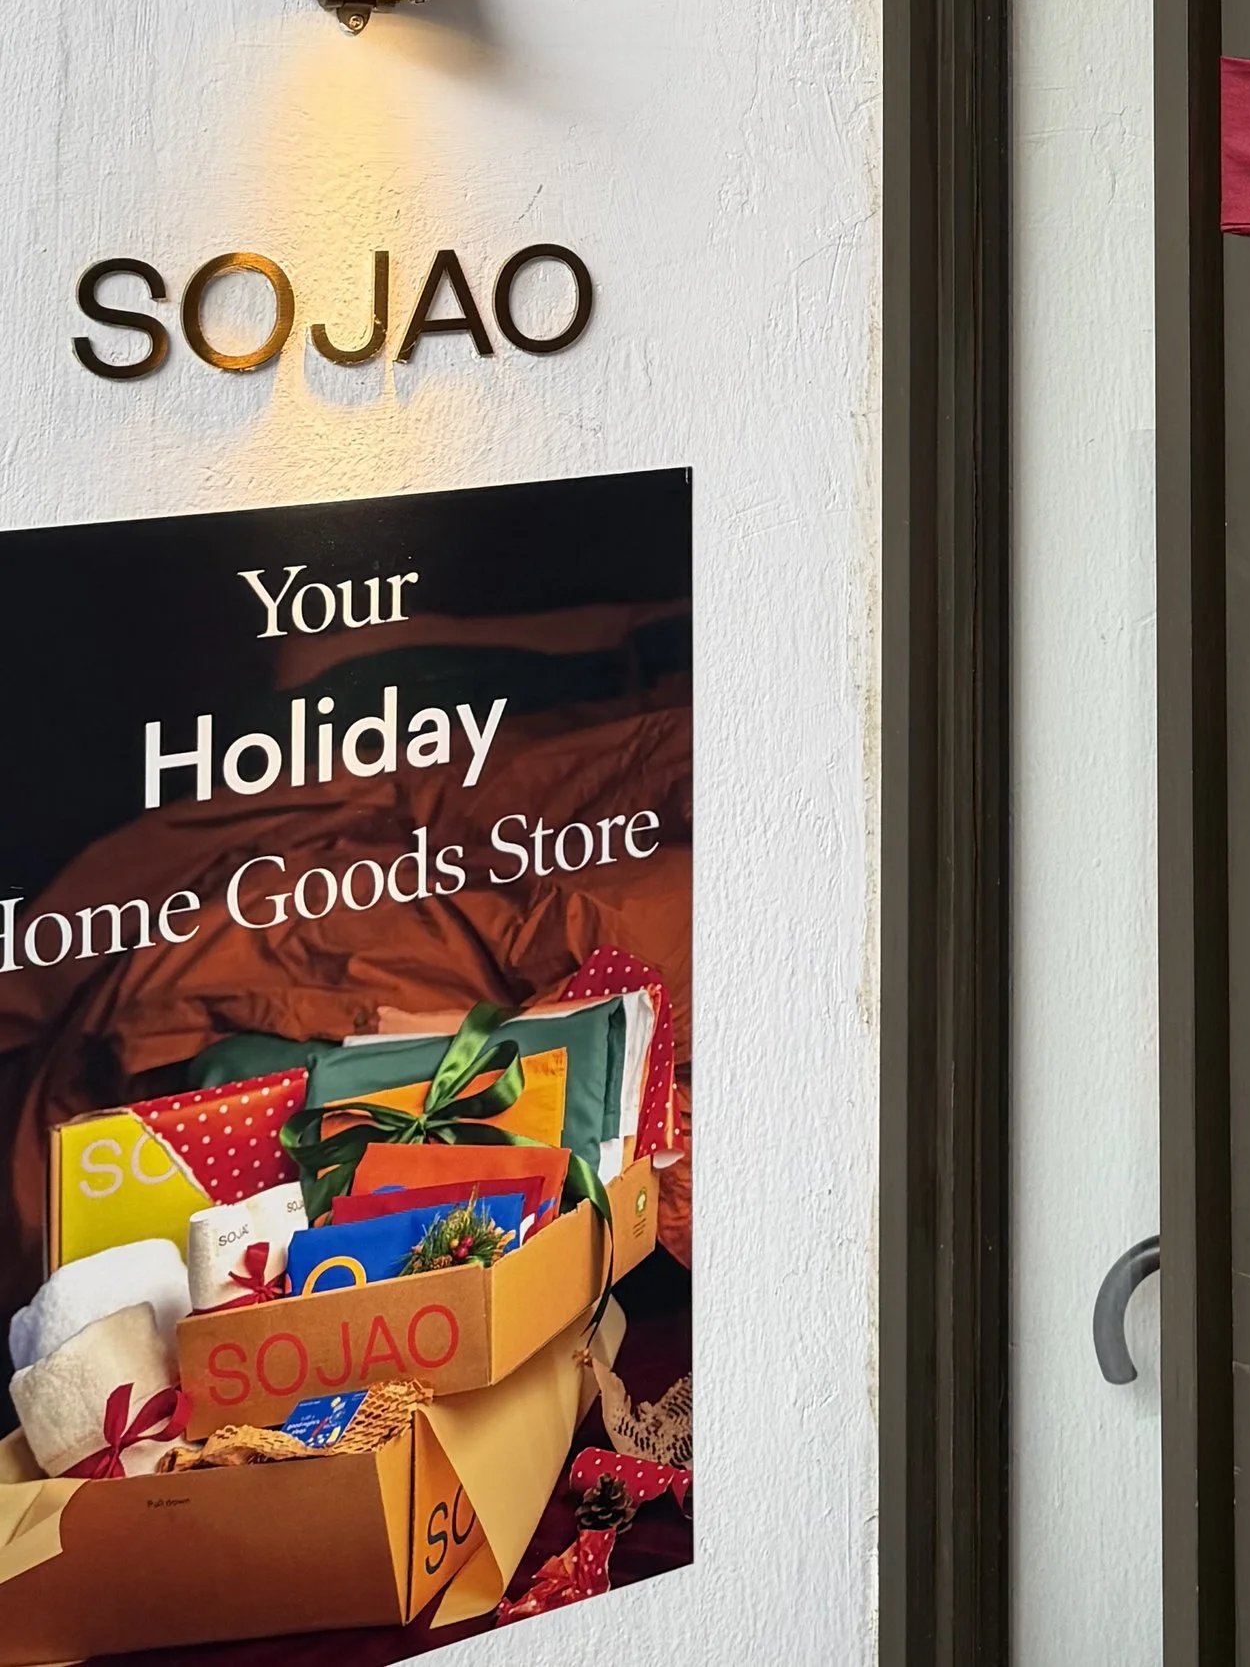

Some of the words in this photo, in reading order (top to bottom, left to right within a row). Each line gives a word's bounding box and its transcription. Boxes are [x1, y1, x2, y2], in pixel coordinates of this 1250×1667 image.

[71, 243, 595, 381] SOJAO
[238, 565, 419, 639] Your
[144, 685, 508, 809] Holiday
[226, 827, 467, 930] Goods
[489, 809, 661, 885] Store
[207, 1304, 460, 1406] SOJAO
